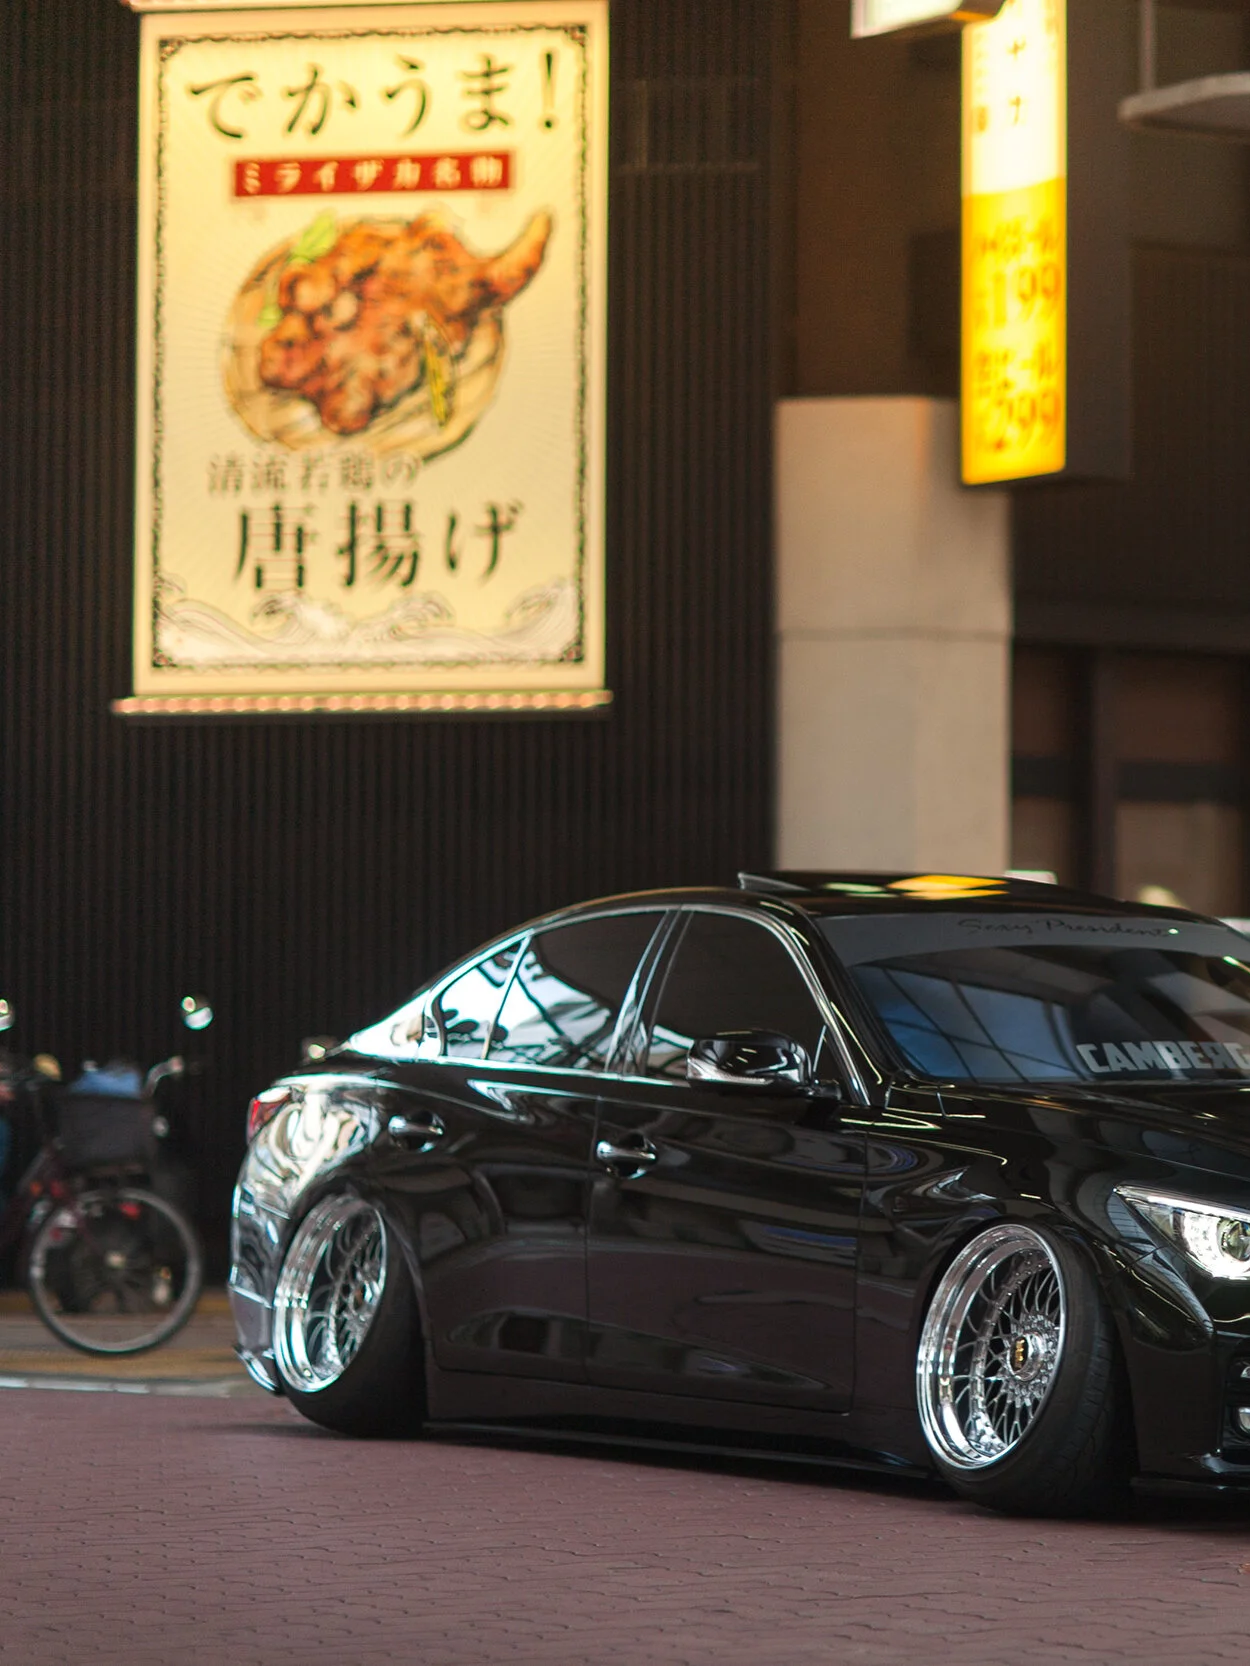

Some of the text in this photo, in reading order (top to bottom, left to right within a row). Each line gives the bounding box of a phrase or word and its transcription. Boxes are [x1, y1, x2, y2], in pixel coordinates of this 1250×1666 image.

[188, 51, 556, 140] でかうま!
[234, 499, 525, 593] 唐揚げ
